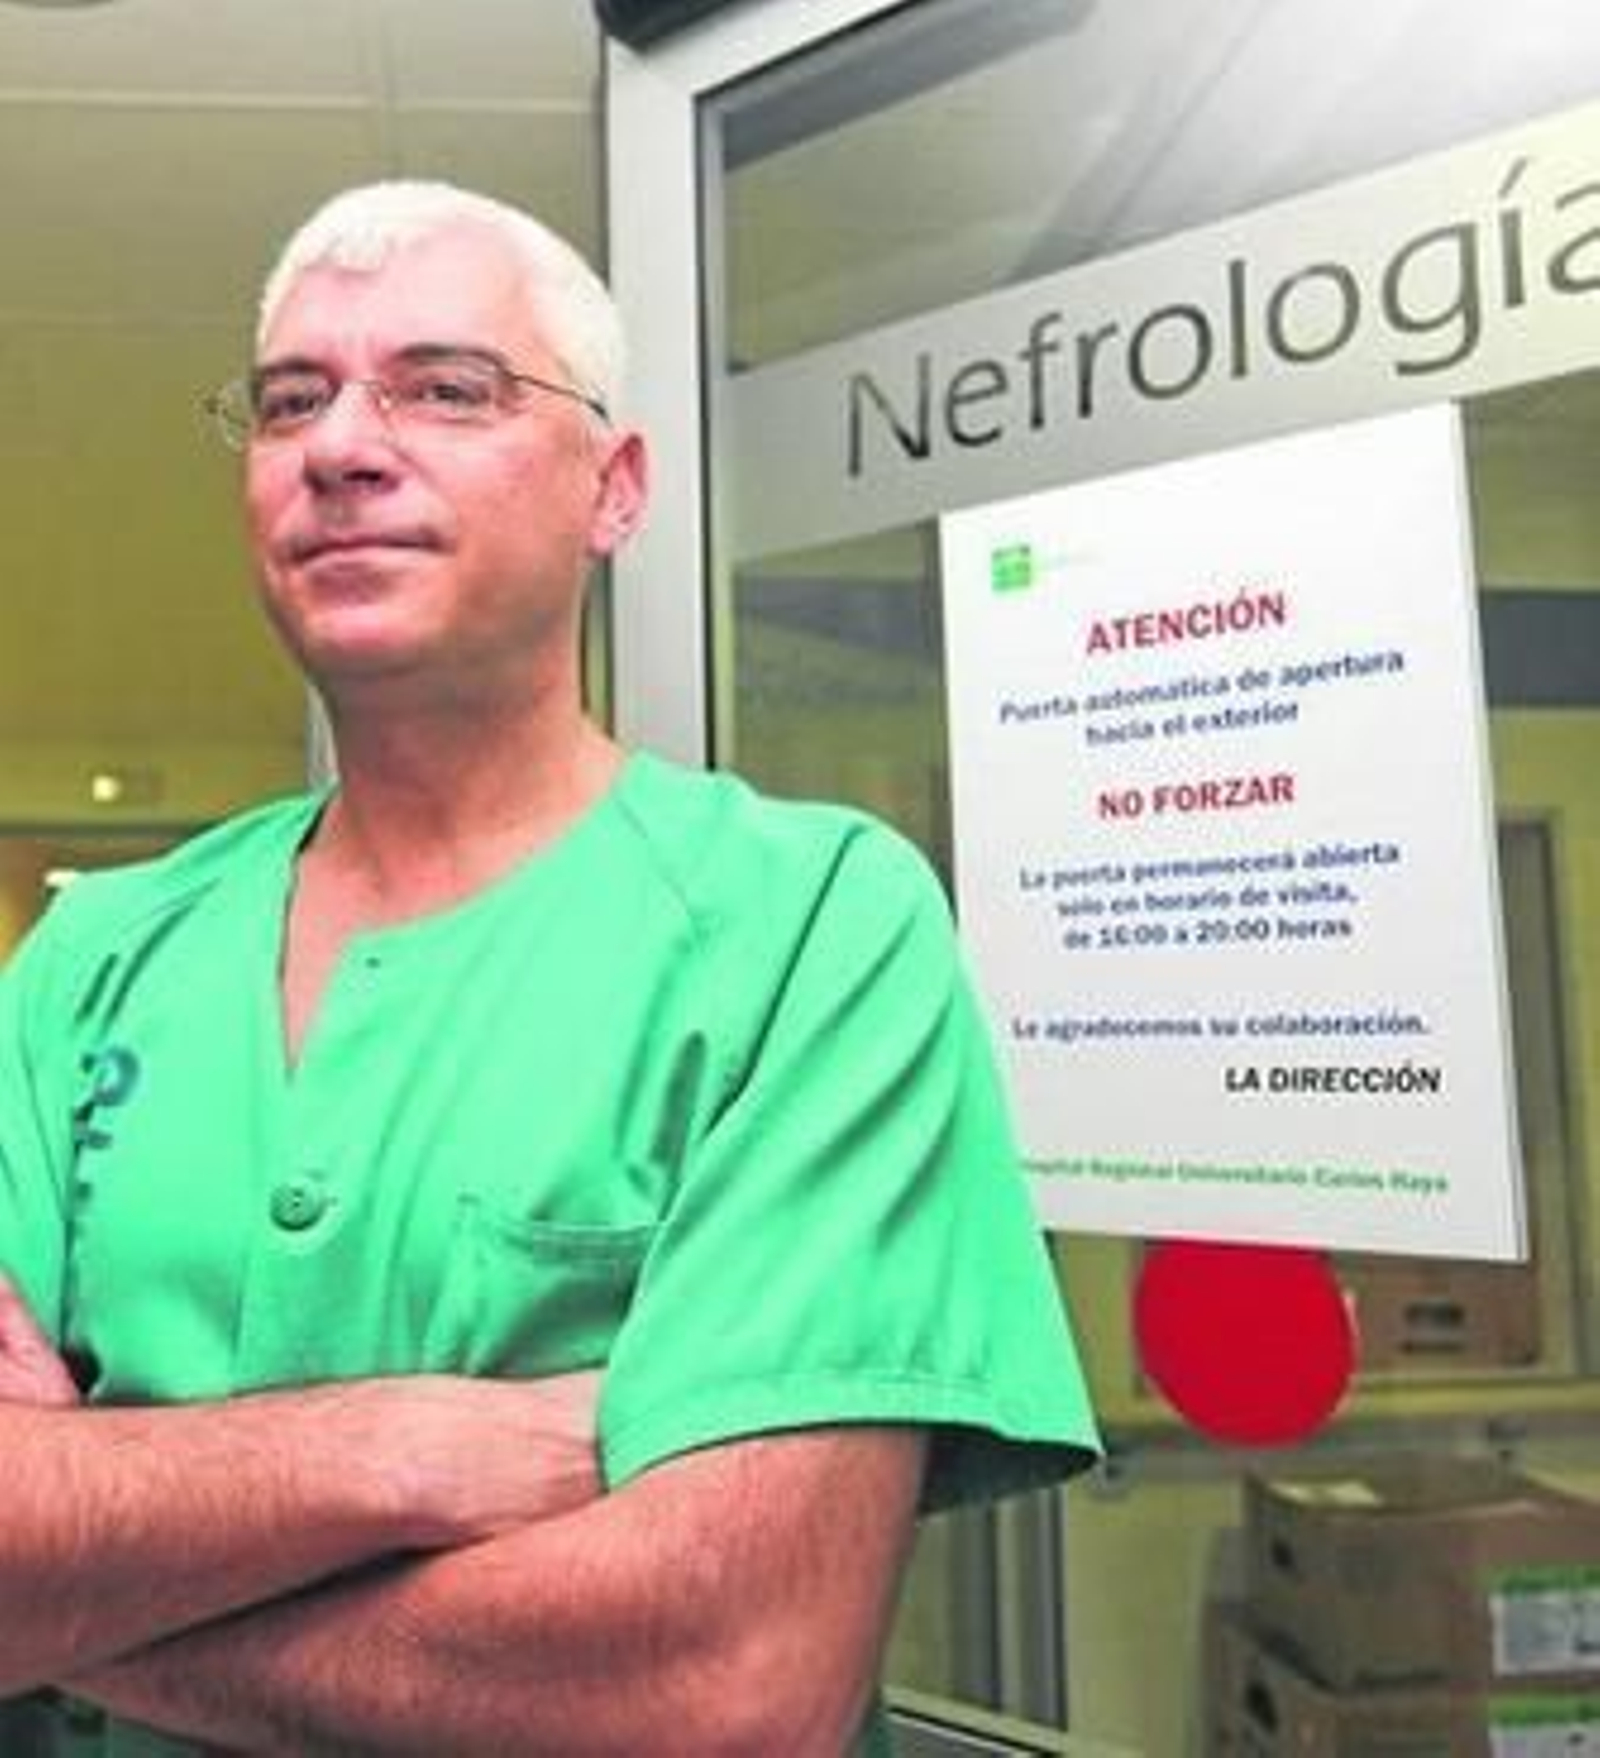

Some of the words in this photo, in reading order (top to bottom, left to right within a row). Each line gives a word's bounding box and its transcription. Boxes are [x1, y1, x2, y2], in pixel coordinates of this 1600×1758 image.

[848, 156, 1600, 478] Nefrología
[1086, 586, 1286, 655] ATENCIÓN
[1000, 696, 1079, 724] Puerta
[1236, 667, 1271, 692] de
[1279, 650, 1404, 688] apertura
[1086, 719, 1155, 747] hacia
[1163, 713, 1186, 736] el
[1191, 701, 1298, 732] exterior
[1099, 789, 1144, 820] NO
[1153, 773, 1295, 814] FORZAR
[1020, 866, 1046, 890] La
[1053, 864, 1126, 891] puerta
[1302, 842, 1399, 869] abierta
[1110, 896, 1140, 915] en
[1145, 887, 1232, 912] horario
[1238, 883, 1270, 906] de
[1063, 928, 1092, 950] de
[1174, 926, 1189, 944] a
[1196, 919, 1270, 944] 20:00
[1277, 917, 1353, 940] horas
[1014, 1017, 1038, 1041] Le
[1045, 1016, 1203, 1046] agradecemos
[1210, 1018, 1239, 1037] su
[1225, 1067, 1261, 1093] LA
[1268, 1058, 1441, 1094] DIRECCIÓN
